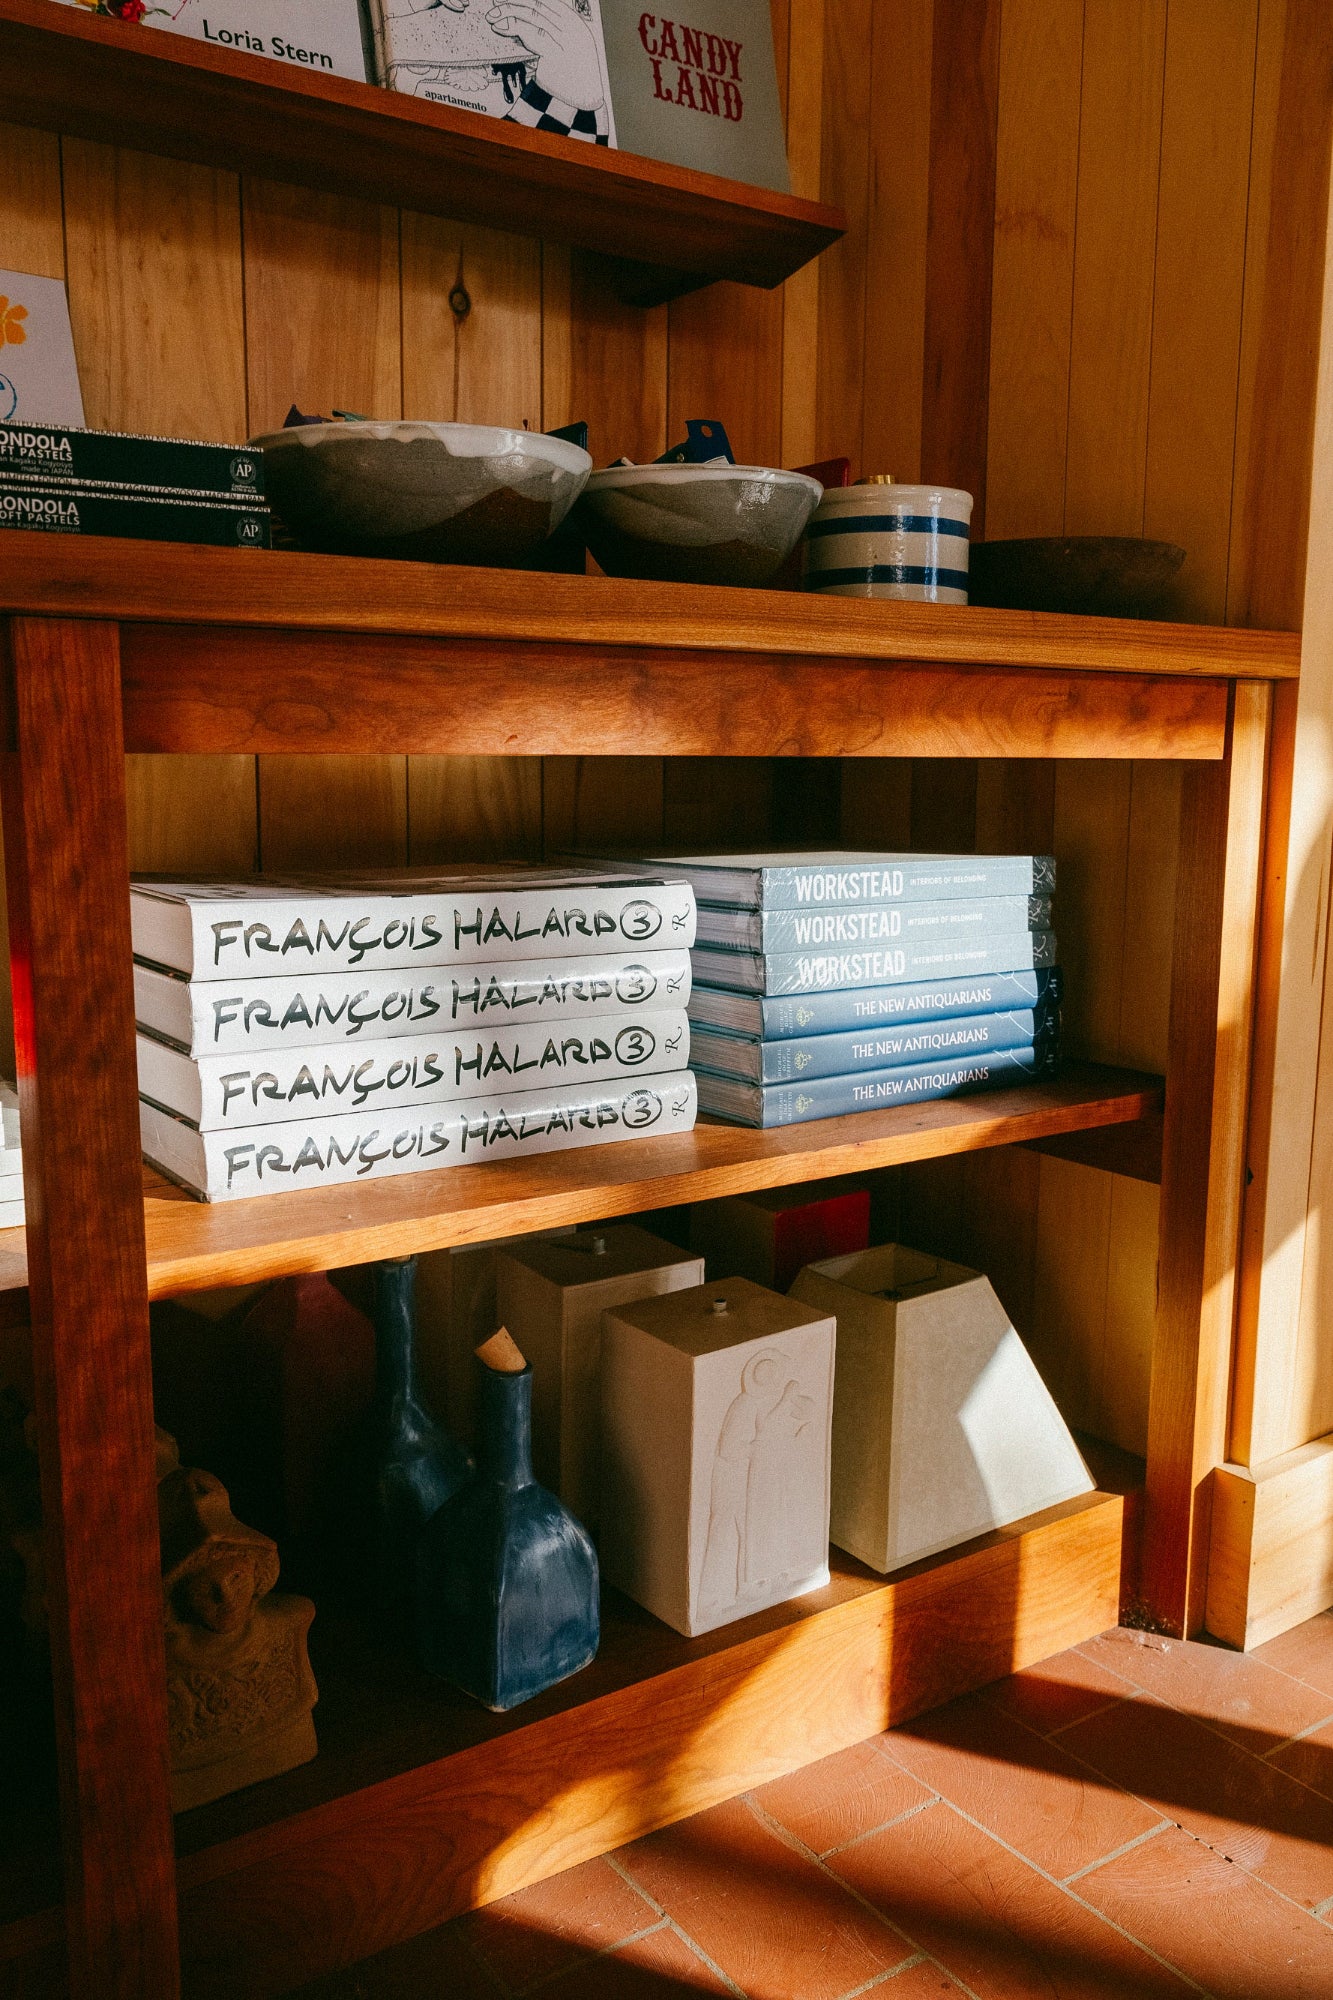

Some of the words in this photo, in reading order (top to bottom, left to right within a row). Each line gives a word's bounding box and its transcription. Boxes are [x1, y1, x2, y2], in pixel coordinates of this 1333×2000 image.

[202, 19, 265, 52] Loria
[271, 37, 334, 69] Stern
[637, 12, 743, 82] CANDY
[424, 89, 488, 113] apartamento
[649, 57, 744, 122] LAND
[20, 447, 73, 461] PASTELS
[236, 463, 252, 477] AP
[51, 467, 74, 476] JAPAN
[0, 496, 79, 516] ONDOLA
[28, 512, 80, 526] PASTELS
[242, 524, 259, 537] AP
[795, 870, 904, 902] WORKSTEAD
[210, 915, 443, 966] FRANÇOIS
[453, 906, 617, 950] HALARD
[794, 911, 902, 945] WORKSTEAD
[798, 950, 906, 985] WORKSTEAD
[212, 985, 441, 1042] FRANÇOIS
[451, 974, 613, 1019] HALARD
[854, 1000, 877, 1016] THE
[879, 997, 906, 1013] NEW
[906, 988, 992, 1011] ANTIQUARIANS
[852, 1042, 874, 1058] THE
[876, 1039, 902, 1055] NEW
[904, 1028, 989, 1052] ANTIQUARIANS
[219, 1053, 444, 1116] FRANÇOIS
[455, 1038, 613, 1085] HALARD
[853, 1084, 875, 1100] THE
[877, 1080, 903, 1096] NEW
[904, 1067, 989, 1093] ANTIQUARIANS
[223, 1122, 450, 1190] FRANÇOIS
[461, 1104, 619, 1153] HALARD
